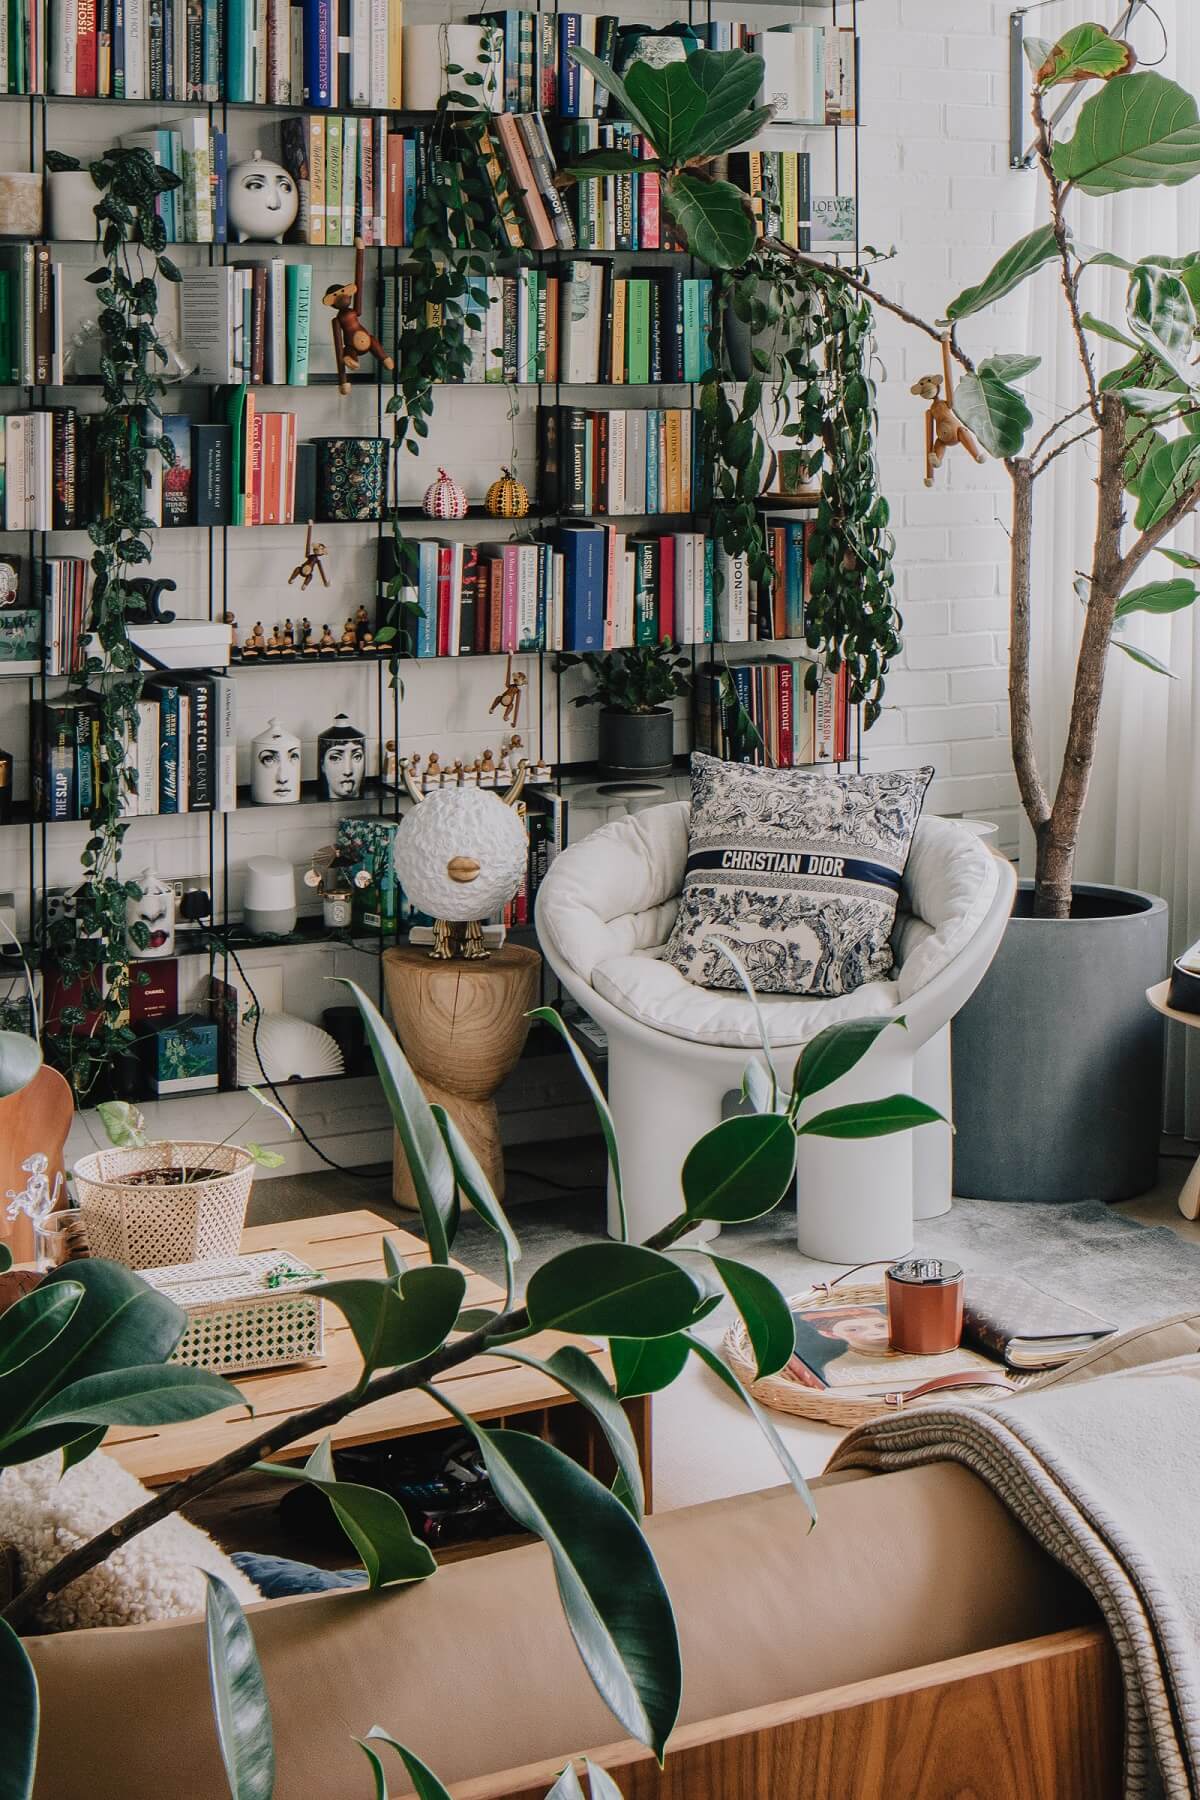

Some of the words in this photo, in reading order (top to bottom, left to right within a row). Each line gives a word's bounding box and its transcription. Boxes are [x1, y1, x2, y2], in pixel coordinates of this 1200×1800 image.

[568, 16, 578, 38] STILL
[318, 1, 328, 90] ASTROBIRTHDAYS
[545, 185, 563, 214] WOOD
[623, 179, 631, 234] MACBRIDE
[811, 199, 855, 213] LOEWE
[298, 286, 310, 323] TIME
[538, 288, 547, 301] 100
[297, 335, 308, 363] TEA
[538, 329, 547, 351] WALKS
[69, 422, 75, 434] WE
[253, 416, 262, 439] Coco
[215, 439, 222, 448] IN
[252, 440, 261, 470] Chanel
[215, 473, 222, 482] OF
[574, 442, 584, 490] Leonardo
[643, 545, 652, 579] LARSSON
[781, 669, 792, 687] the
[197, 687, 208, 751] FARFETCH
[781, 689, 790, 731] rumour
[824, 699, 832, 741] ATKINSON
[56, 773, 67, 799] SLAP
[164, 759, 177, 803] Melmoth
[197, 752, 207, 800] CURATES
[56, 799, 67, 816] THE
[538, 838, 546, 854] THE
[538, 856, 546, 877] BOOK
[721, 850, 800, 873] CHRISTIAN
[808, 857, 845, 877] DIOR
